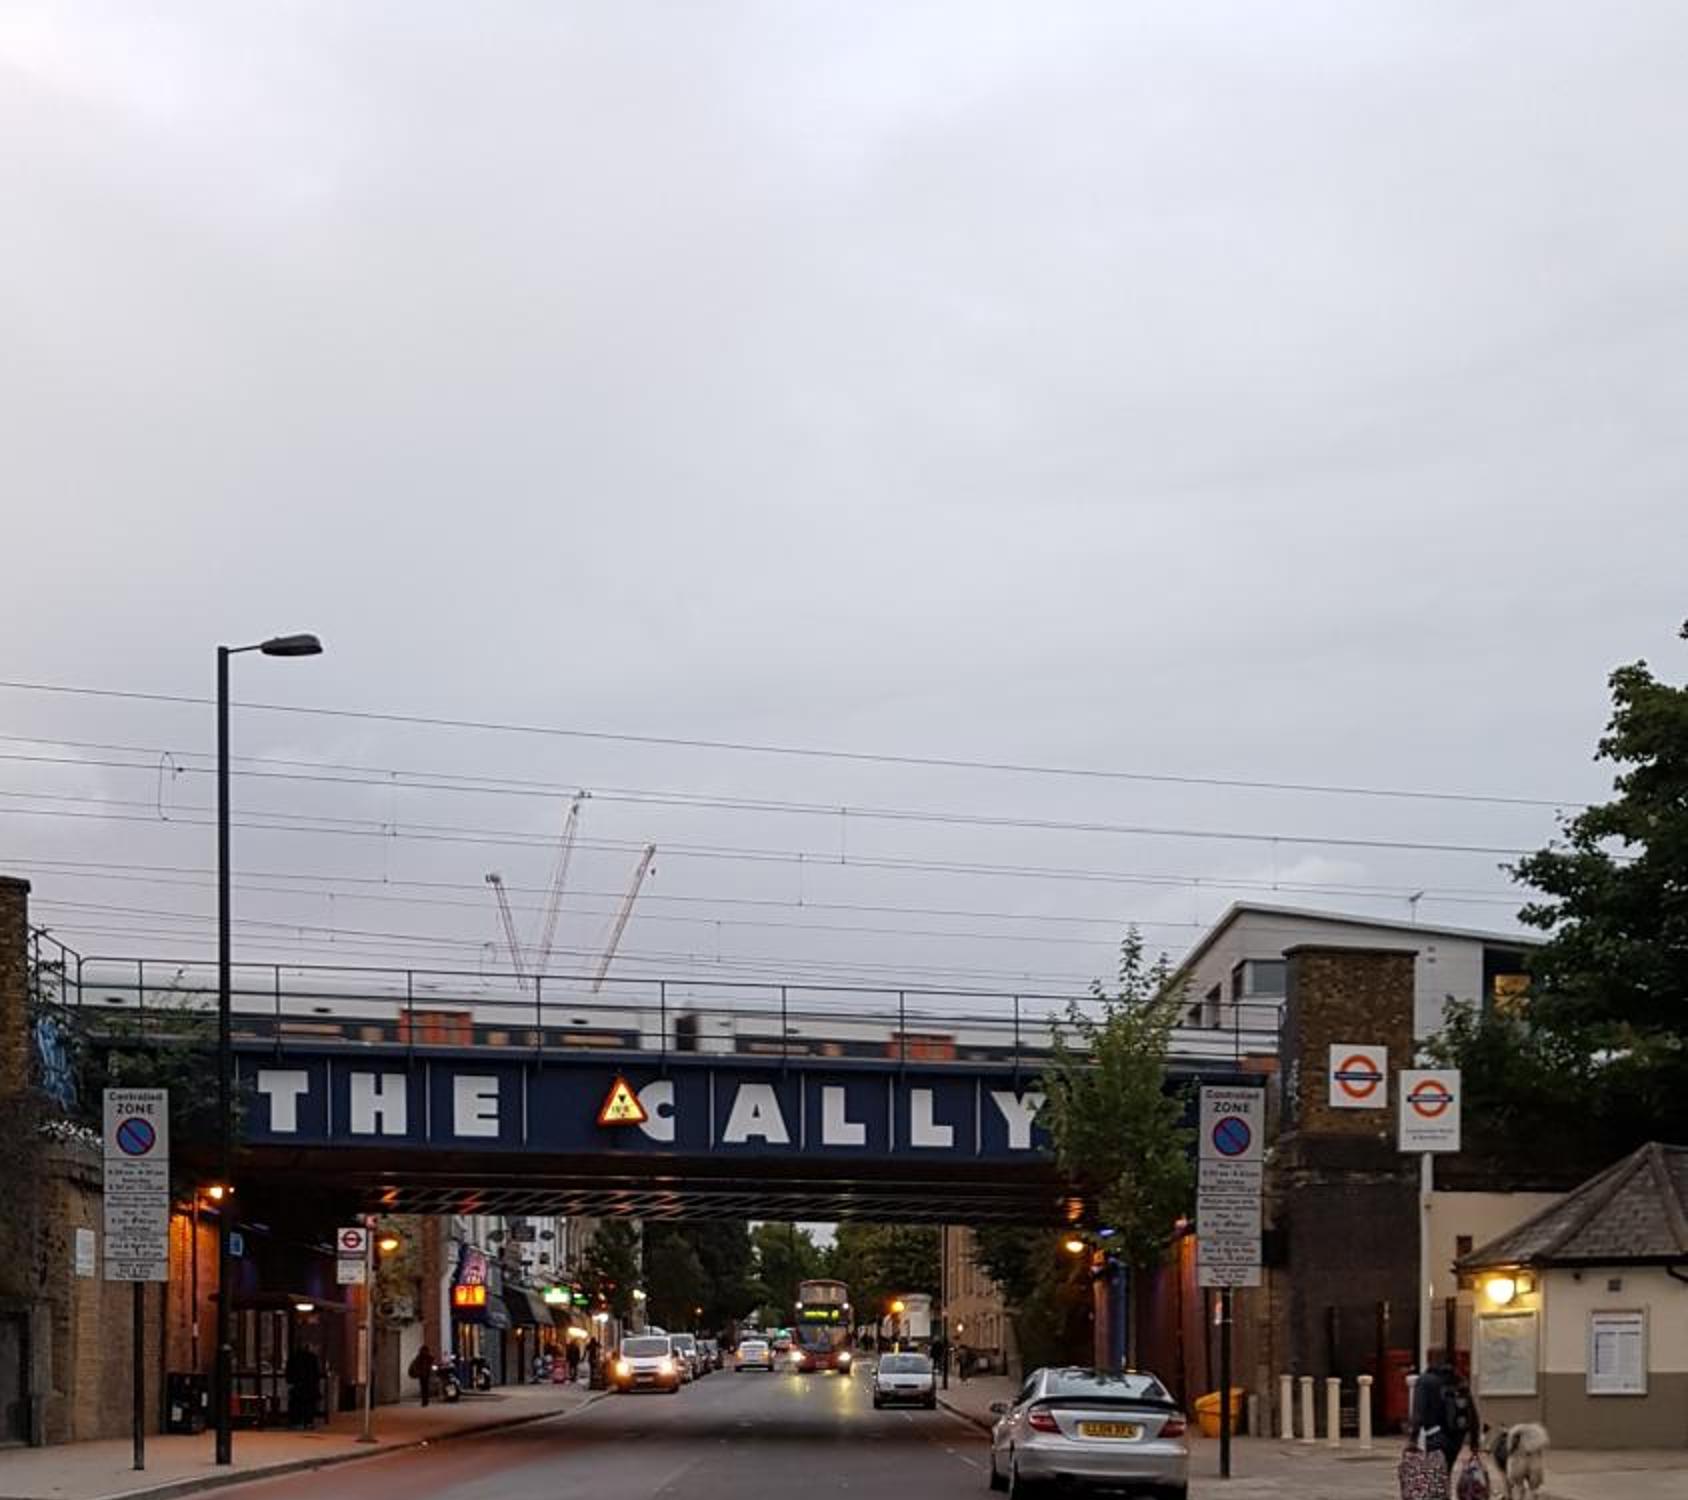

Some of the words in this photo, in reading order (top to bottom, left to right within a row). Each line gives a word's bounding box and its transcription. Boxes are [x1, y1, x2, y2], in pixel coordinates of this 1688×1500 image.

[117, 1102, 155, 1115] ZONE
[257, 1069, 499, 1137] THE
[636, 1080, 1047, 1150] CALLY
[1214, 1102, 1251, 1113] ZONE
